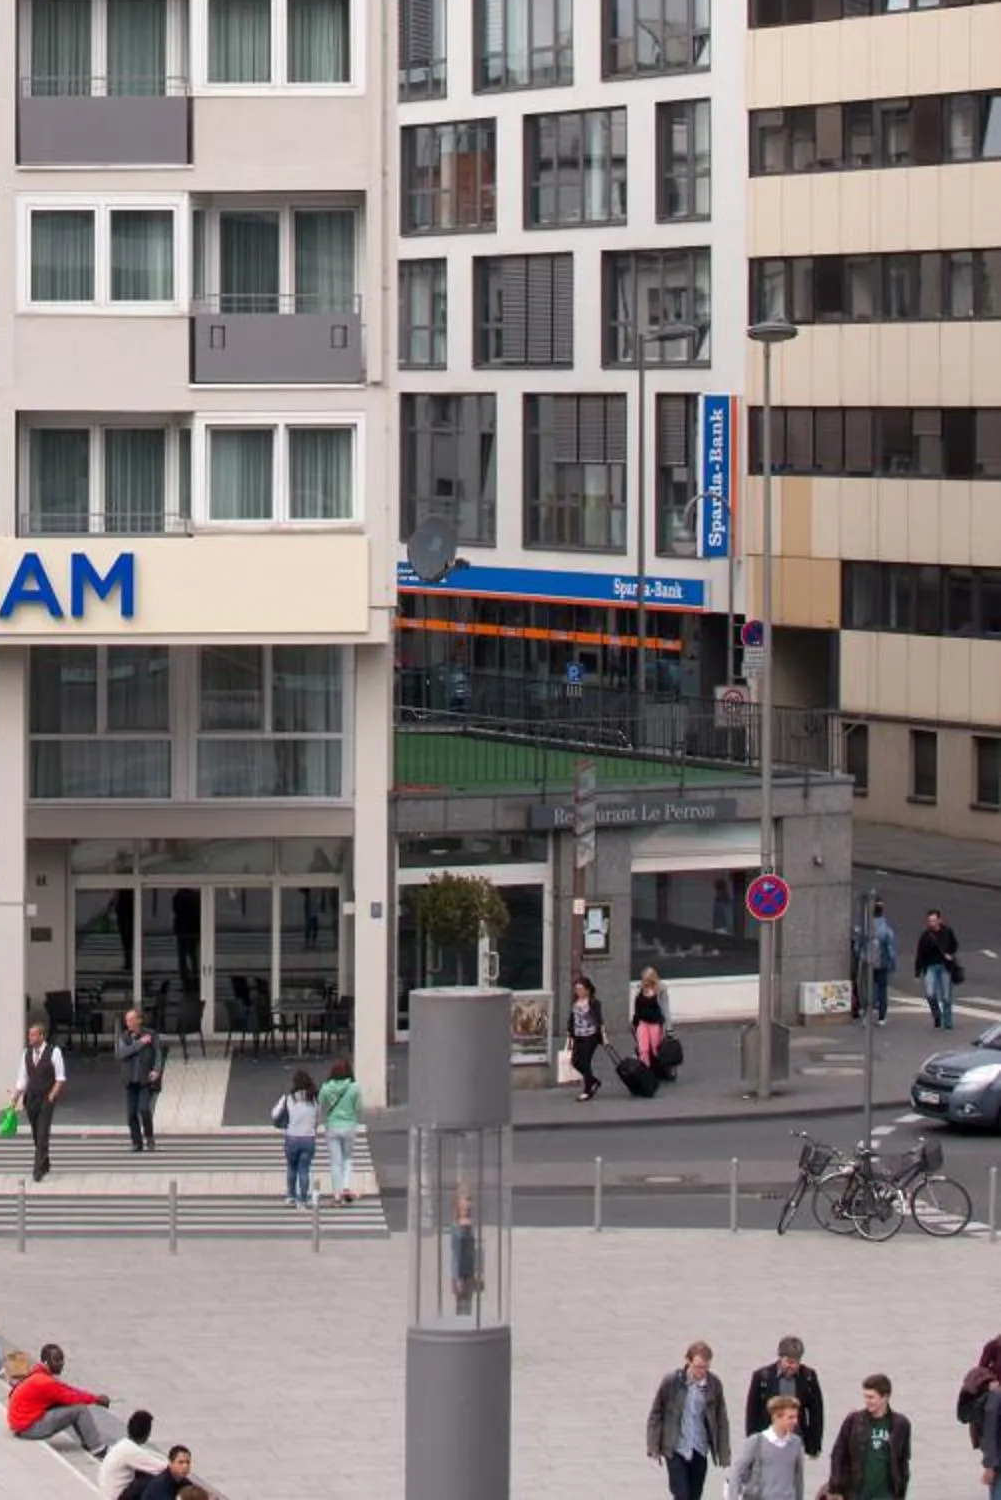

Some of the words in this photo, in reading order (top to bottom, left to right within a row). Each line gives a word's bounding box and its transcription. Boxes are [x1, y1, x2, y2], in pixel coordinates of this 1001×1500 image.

[708, 408, 726, 548] Sparda-Bank
[613, 577, 684, 600] Spara-Bank
[553, 806, 637, 825] Reurant
[642, 803, 661, 822] Le
[664, 803, 716, 821] Perron
